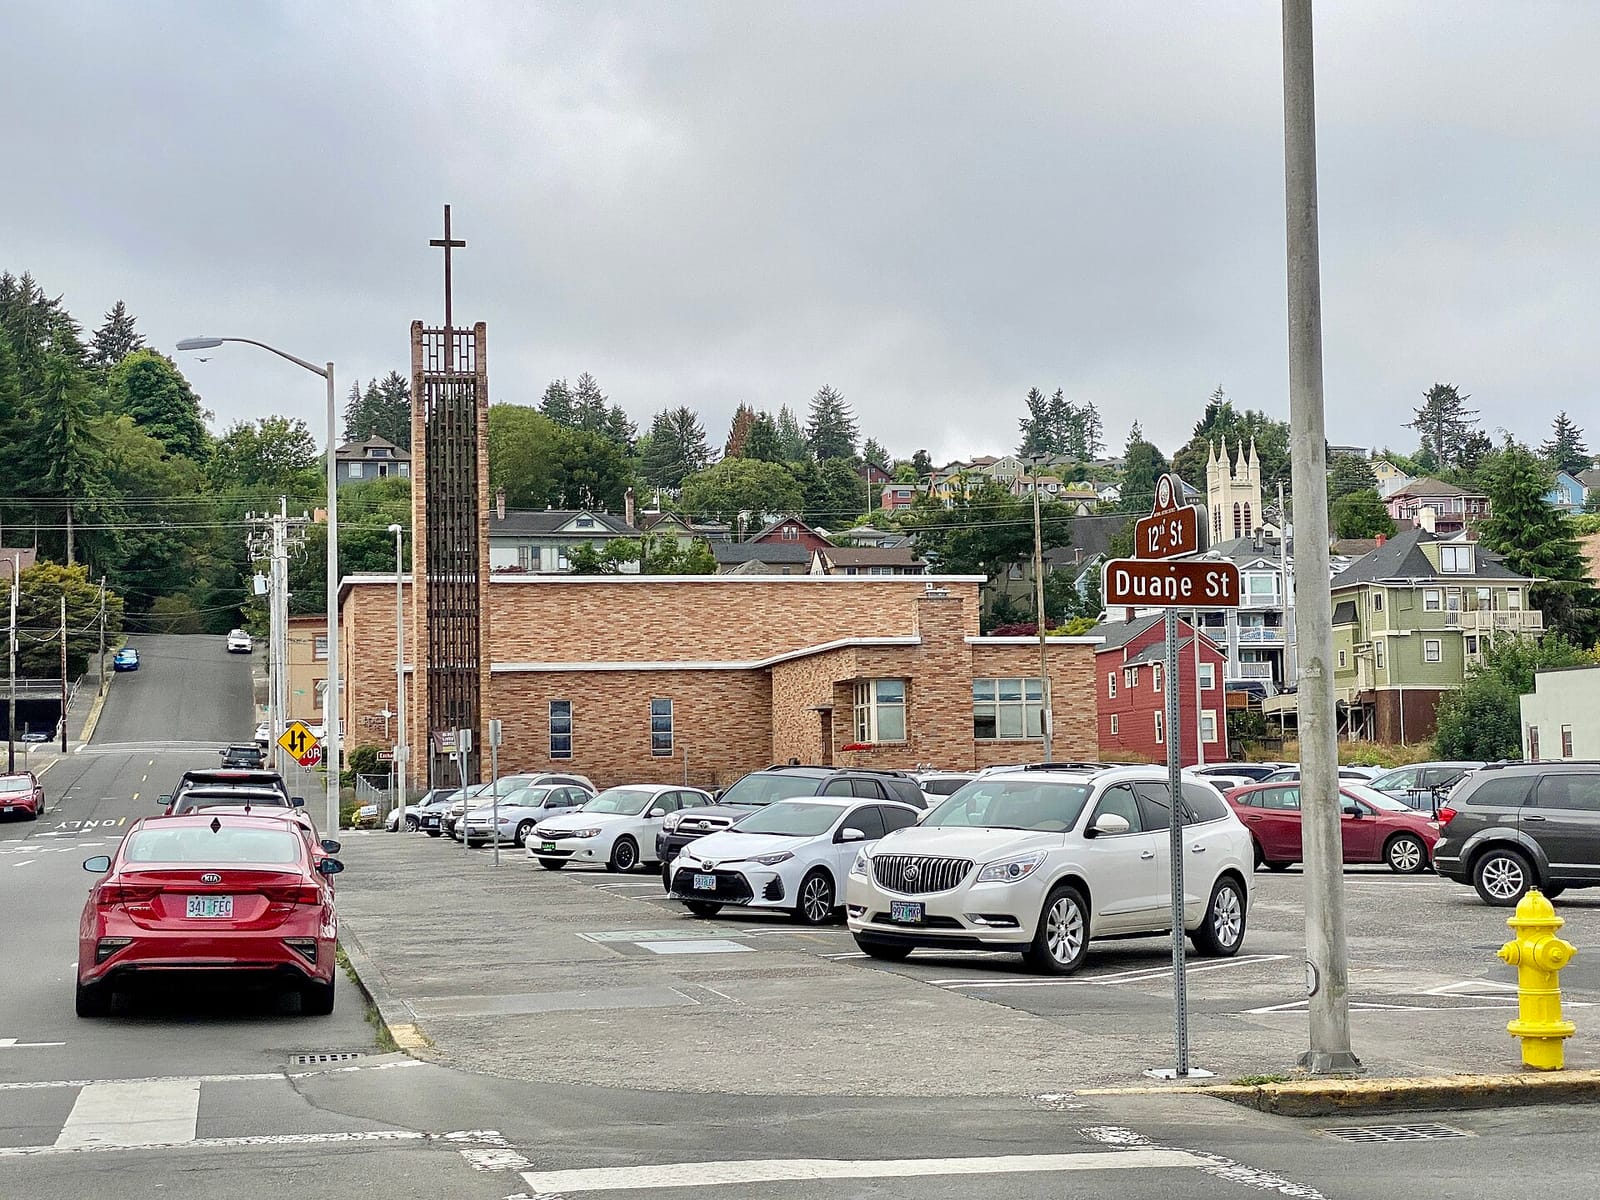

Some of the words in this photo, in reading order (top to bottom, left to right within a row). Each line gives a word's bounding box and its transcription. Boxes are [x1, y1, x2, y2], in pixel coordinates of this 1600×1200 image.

[1170, 519, 1183, 547] St
[1115, 570, 1193, 597] Duane
[1205, 571, 1230, 598] St
[54, 819, 116, 829] ONLY
[203, 874, 219, 883] KIA
[188, 900, 205, 912] 341
[213, 900, 231, 912] FEC
